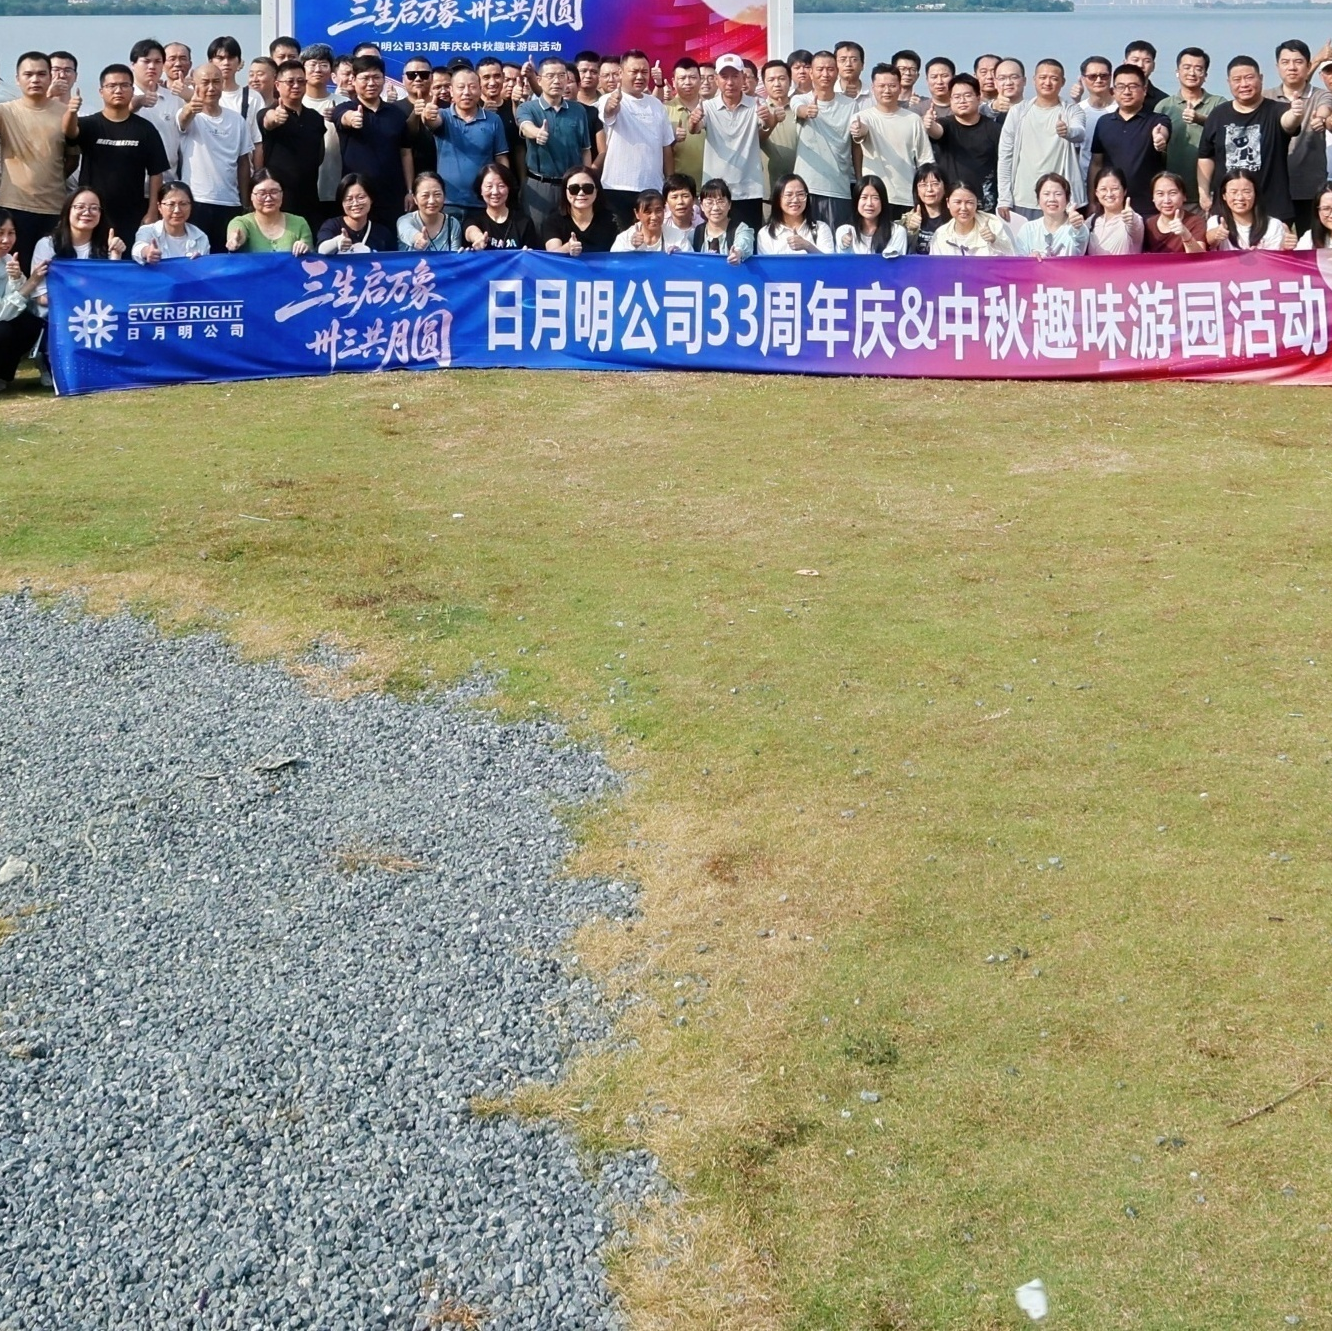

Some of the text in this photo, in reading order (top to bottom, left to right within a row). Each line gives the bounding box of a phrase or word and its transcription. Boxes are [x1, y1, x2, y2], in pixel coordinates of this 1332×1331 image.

[360, 41, 562, 52] 明公司33周年庆&中秋趣味游园活动
[274, 259, 449, 323] 三生启万象
[127, 304, 244, 321] EVERBRIGHT
[487, 275, 1329, 360] 日月明公司33周年庆&中秋趣味游园活动
[127, 324, 244, 341] 日月明公司
